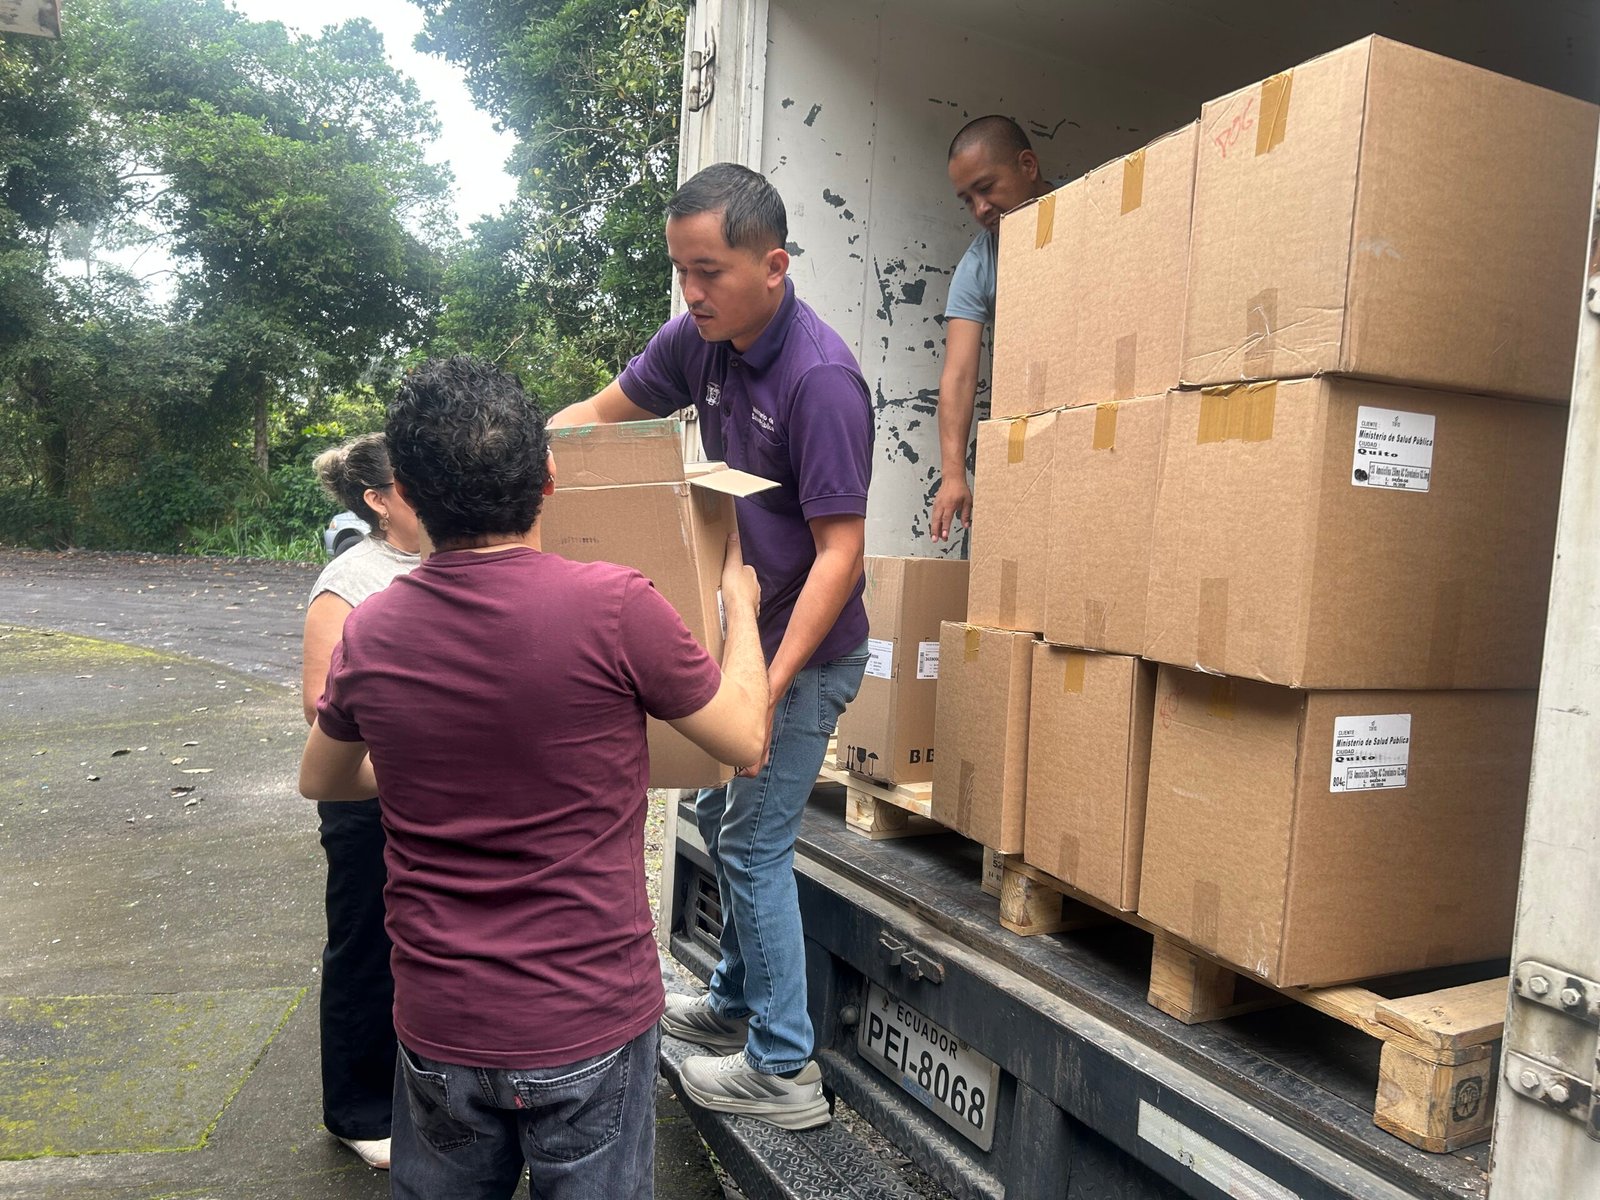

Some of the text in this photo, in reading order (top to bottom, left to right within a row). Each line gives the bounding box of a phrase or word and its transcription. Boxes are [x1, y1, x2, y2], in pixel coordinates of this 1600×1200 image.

[1359, 430, 1387, 441] Ministerio
[1388, 433, 1395, 442] de
[1396, 434, 1412, 444] Salud
[1358, 448, 1398, 457] Quito
[1336, 738, 1364, 747] Ministerio
[1365, 737, 1372, 746] de
[1373, 737, 1388, 746] Salud
[897, 1004, 958, 1060] ECUADOR
[867, 1012, 985, 1130] PEI-8068
